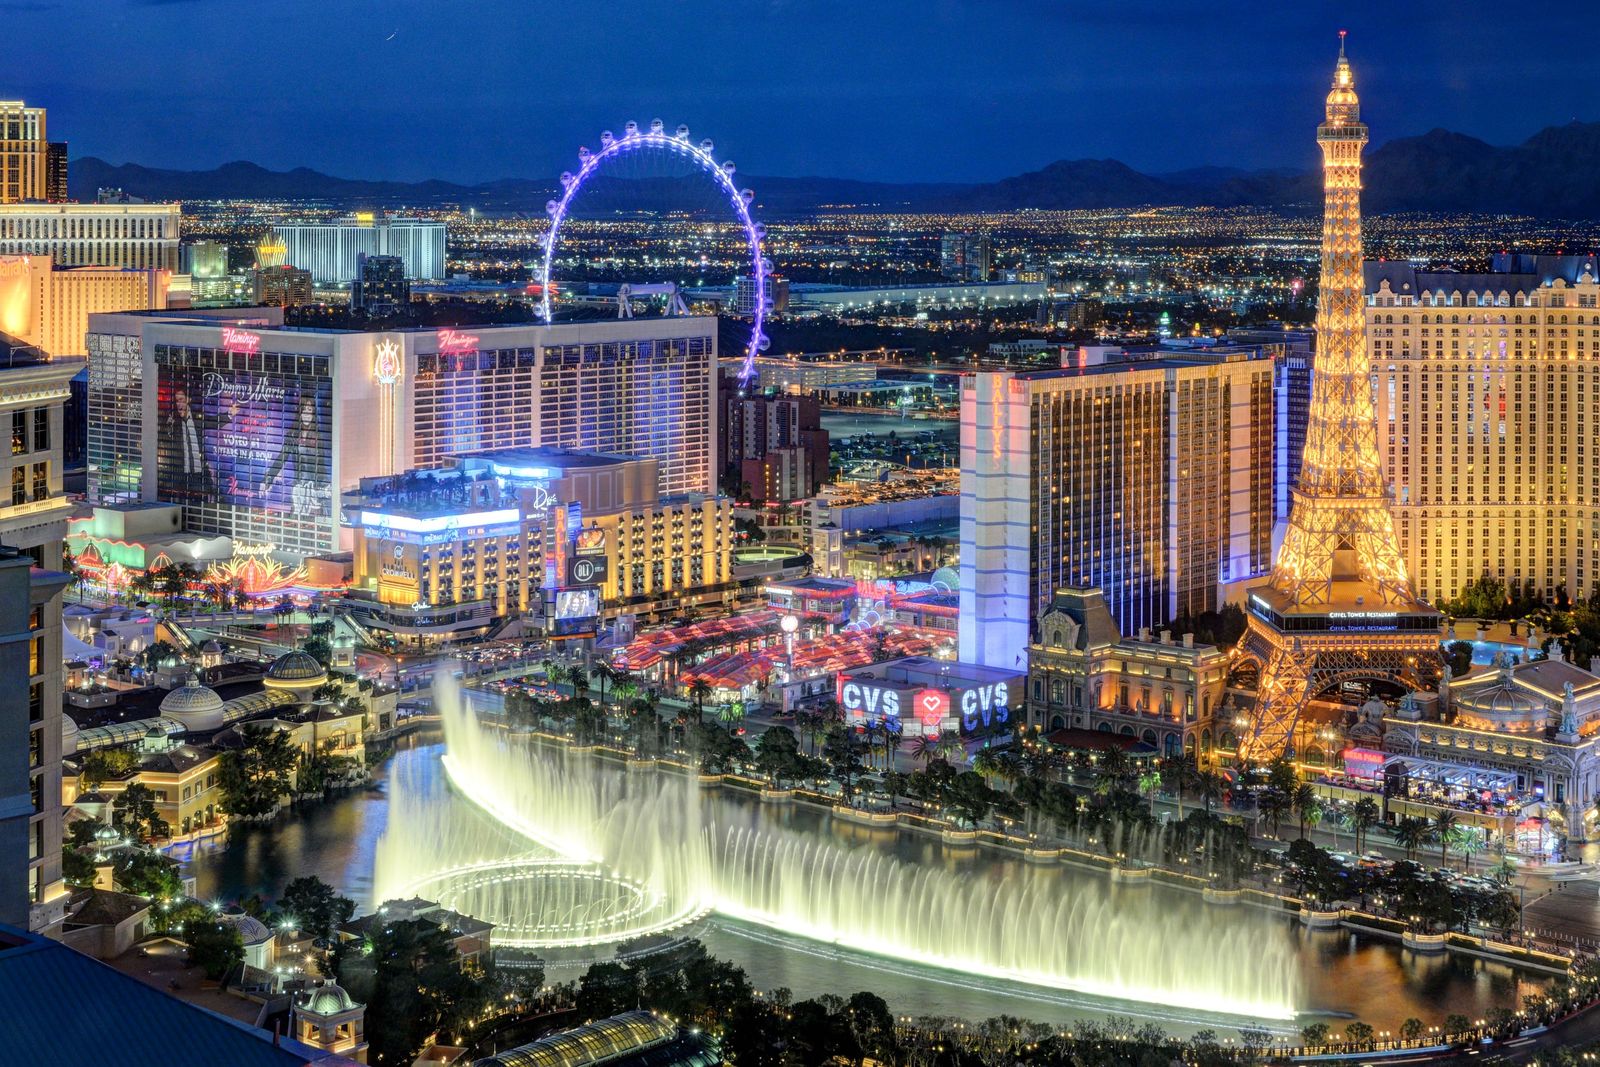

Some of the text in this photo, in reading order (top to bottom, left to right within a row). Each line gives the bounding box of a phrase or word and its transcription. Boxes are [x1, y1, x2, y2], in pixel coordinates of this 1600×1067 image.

[223, 328, 259, 348] Flamingo
[202, 371, 246, 399] Donny
[245, 376, 285, 403] Marie
[223, 433, 248, 446] VOTED
[232, 540, 276, 558] Flamingo
[578, 563, 590, 577] BLT
[843, 684, 899, 715] CVS
[962, 682, 1008, 715] CVS
